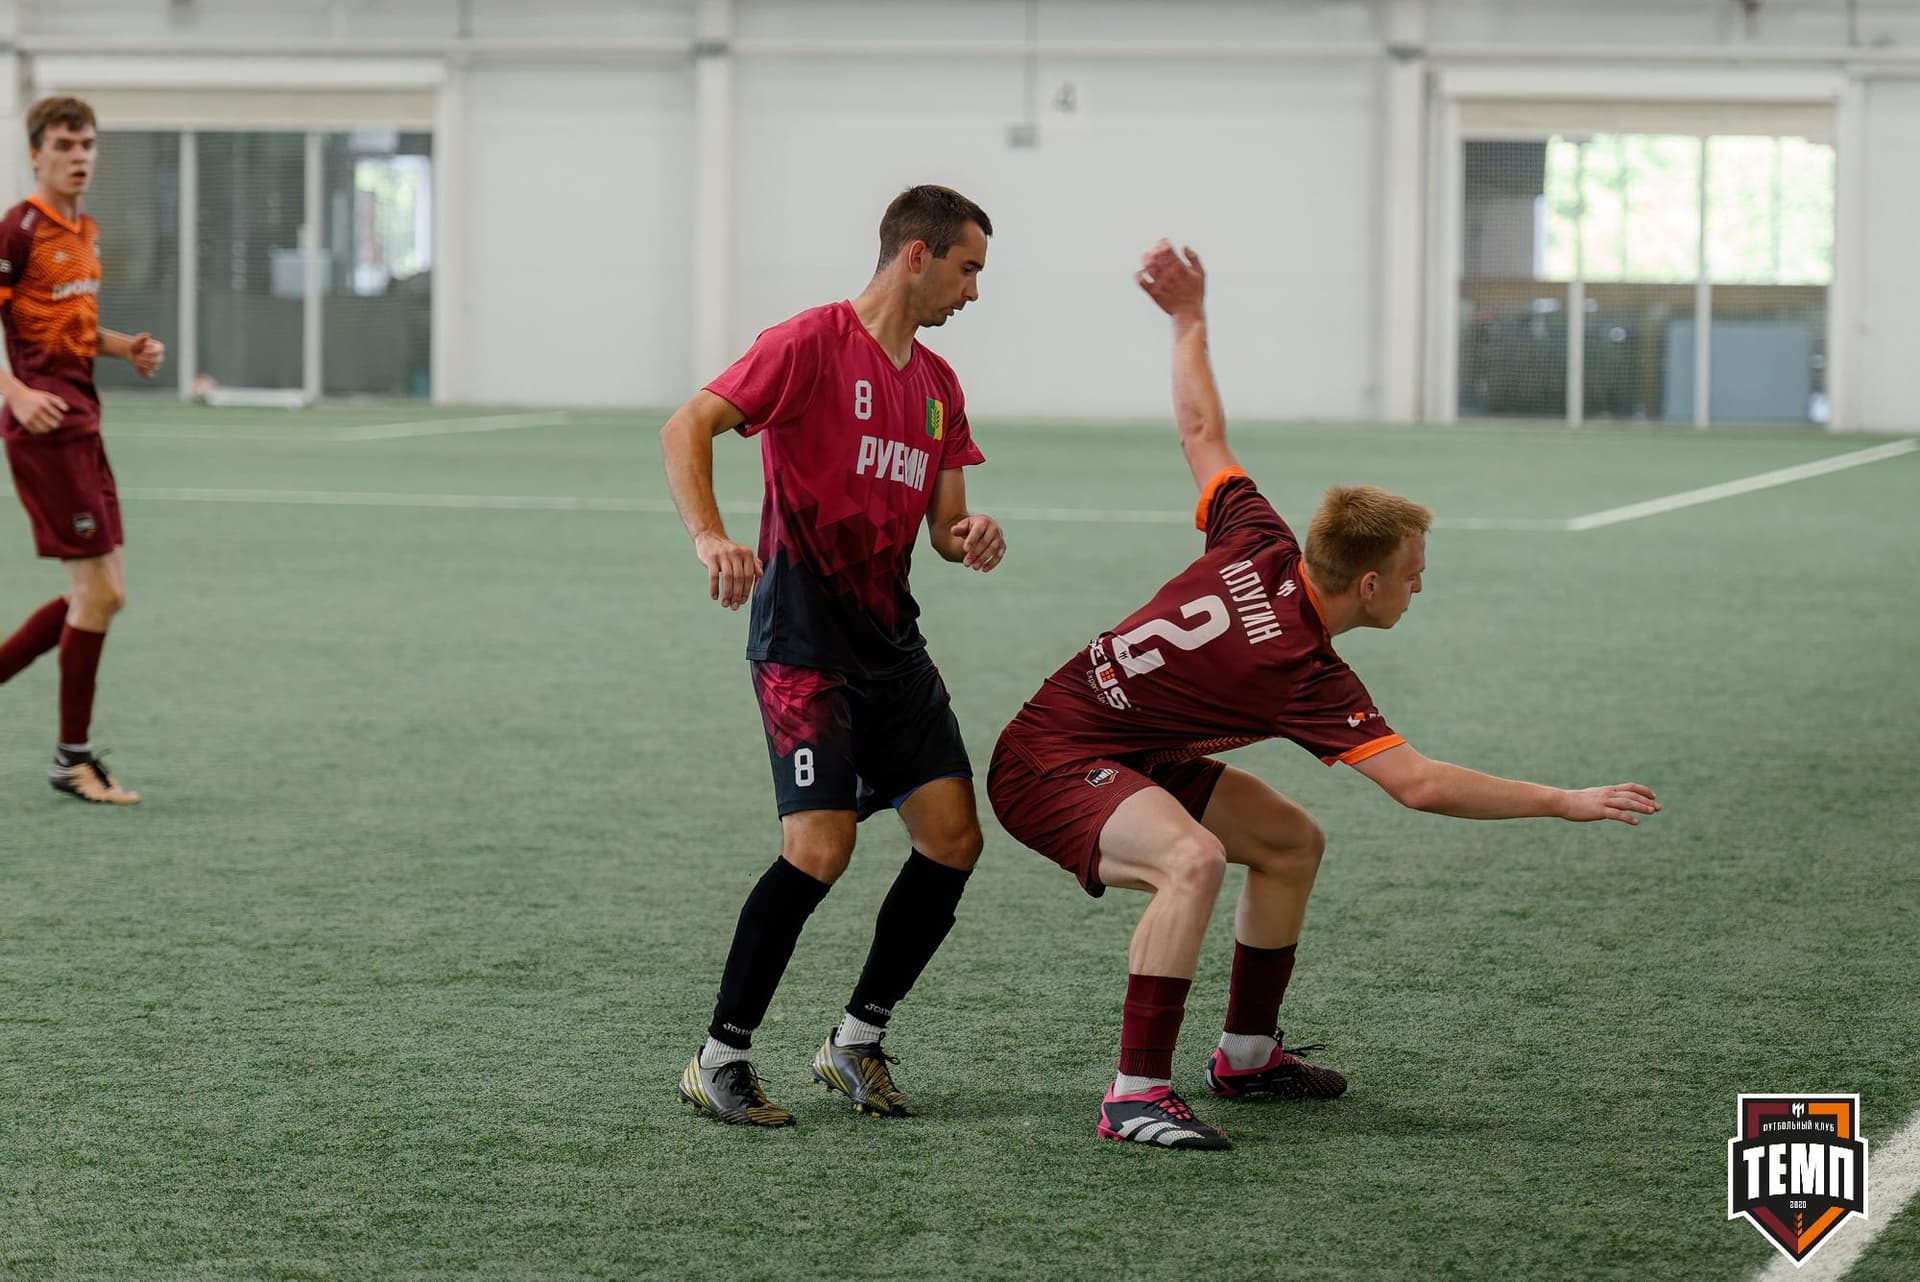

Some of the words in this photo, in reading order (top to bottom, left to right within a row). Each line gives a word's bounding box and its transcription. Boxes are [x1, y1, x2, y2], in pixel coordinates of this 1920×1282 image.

[855, 380, 872, 420] 8
[856, 435, 929, 492] РУБИН
[1111, 594, 1231, 679] 2
[795, 748, 815, 787] 8
